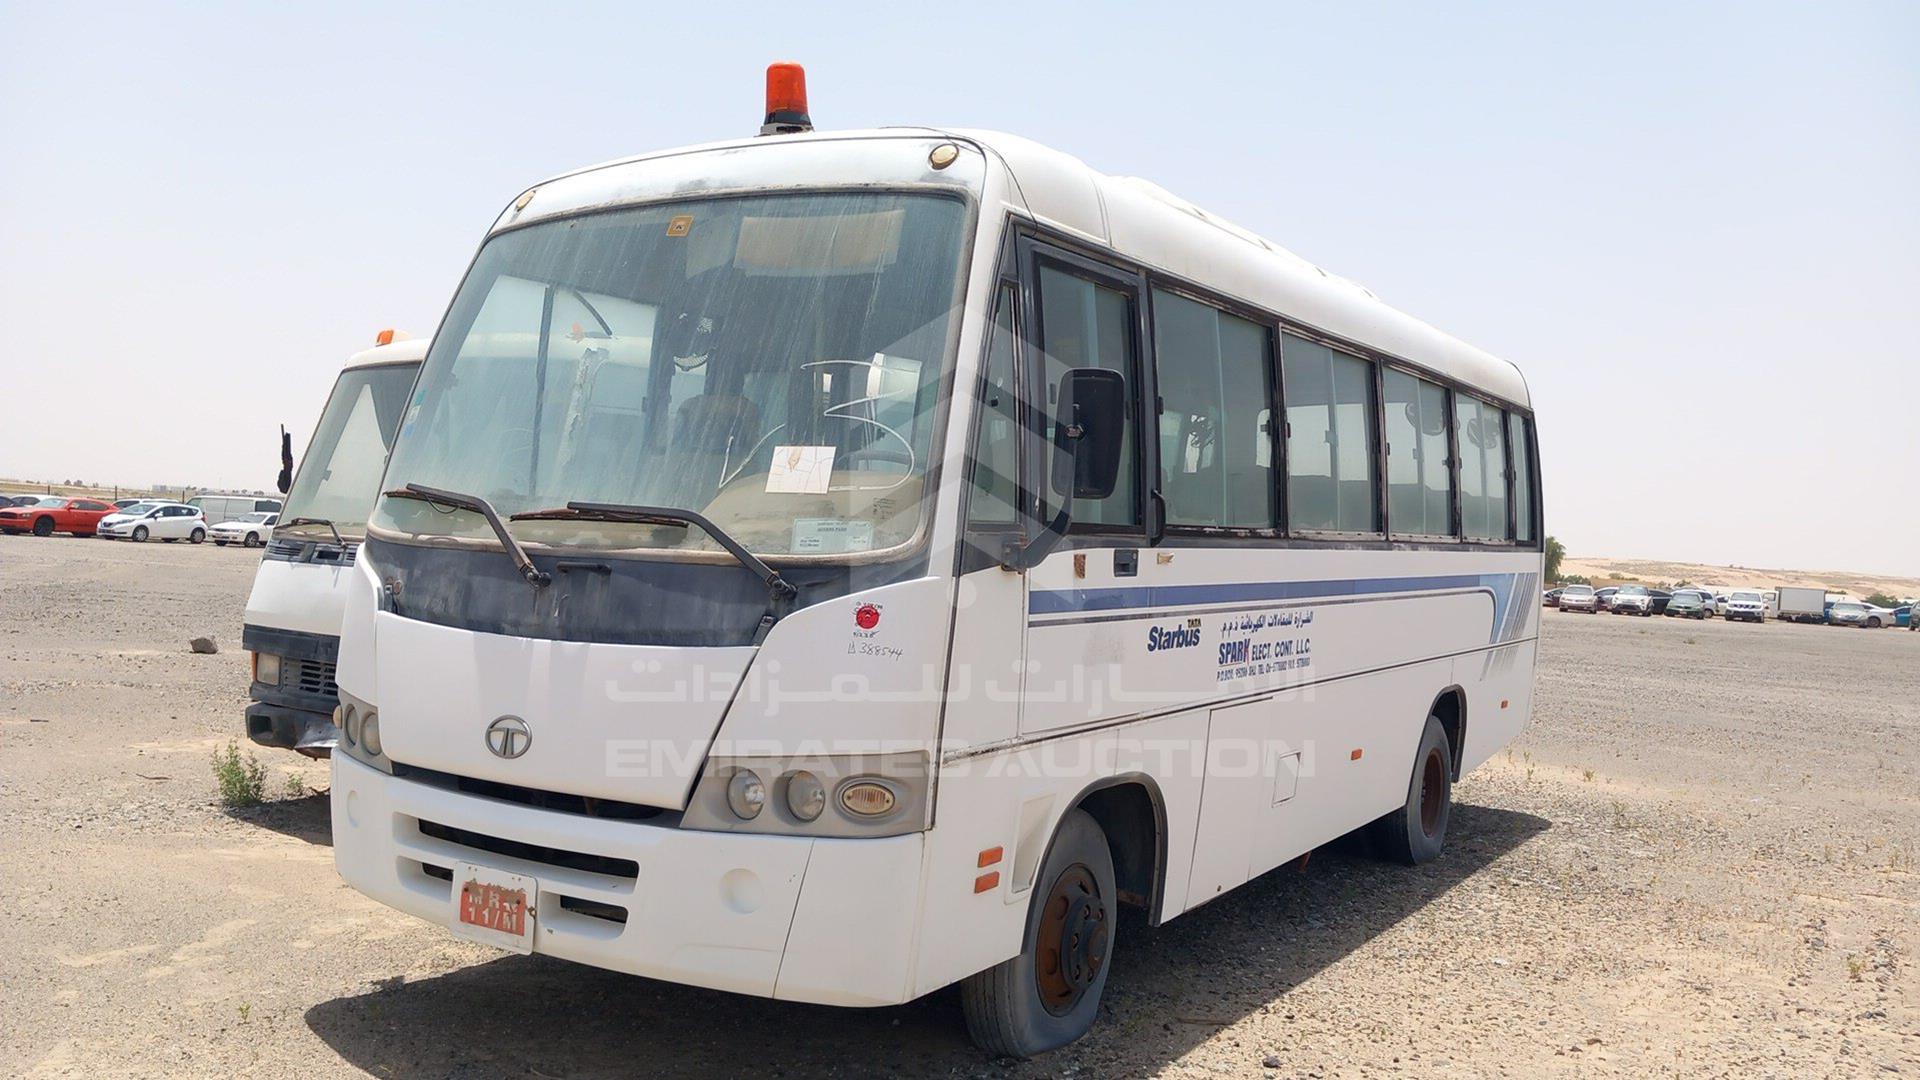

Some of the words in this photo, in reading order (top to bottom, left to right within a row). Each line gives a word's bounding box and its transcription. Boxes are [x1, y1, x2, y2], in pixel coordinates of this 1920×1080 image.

[1187, 617, 1201, 628] TATA
[1147, 624, 1201, 652] Starbus
[1218, 639, 1251, 665] SPARK
[1251, 643, 1272, 661] ELECT.
[1275, 640, 1294, 658] CONT.
